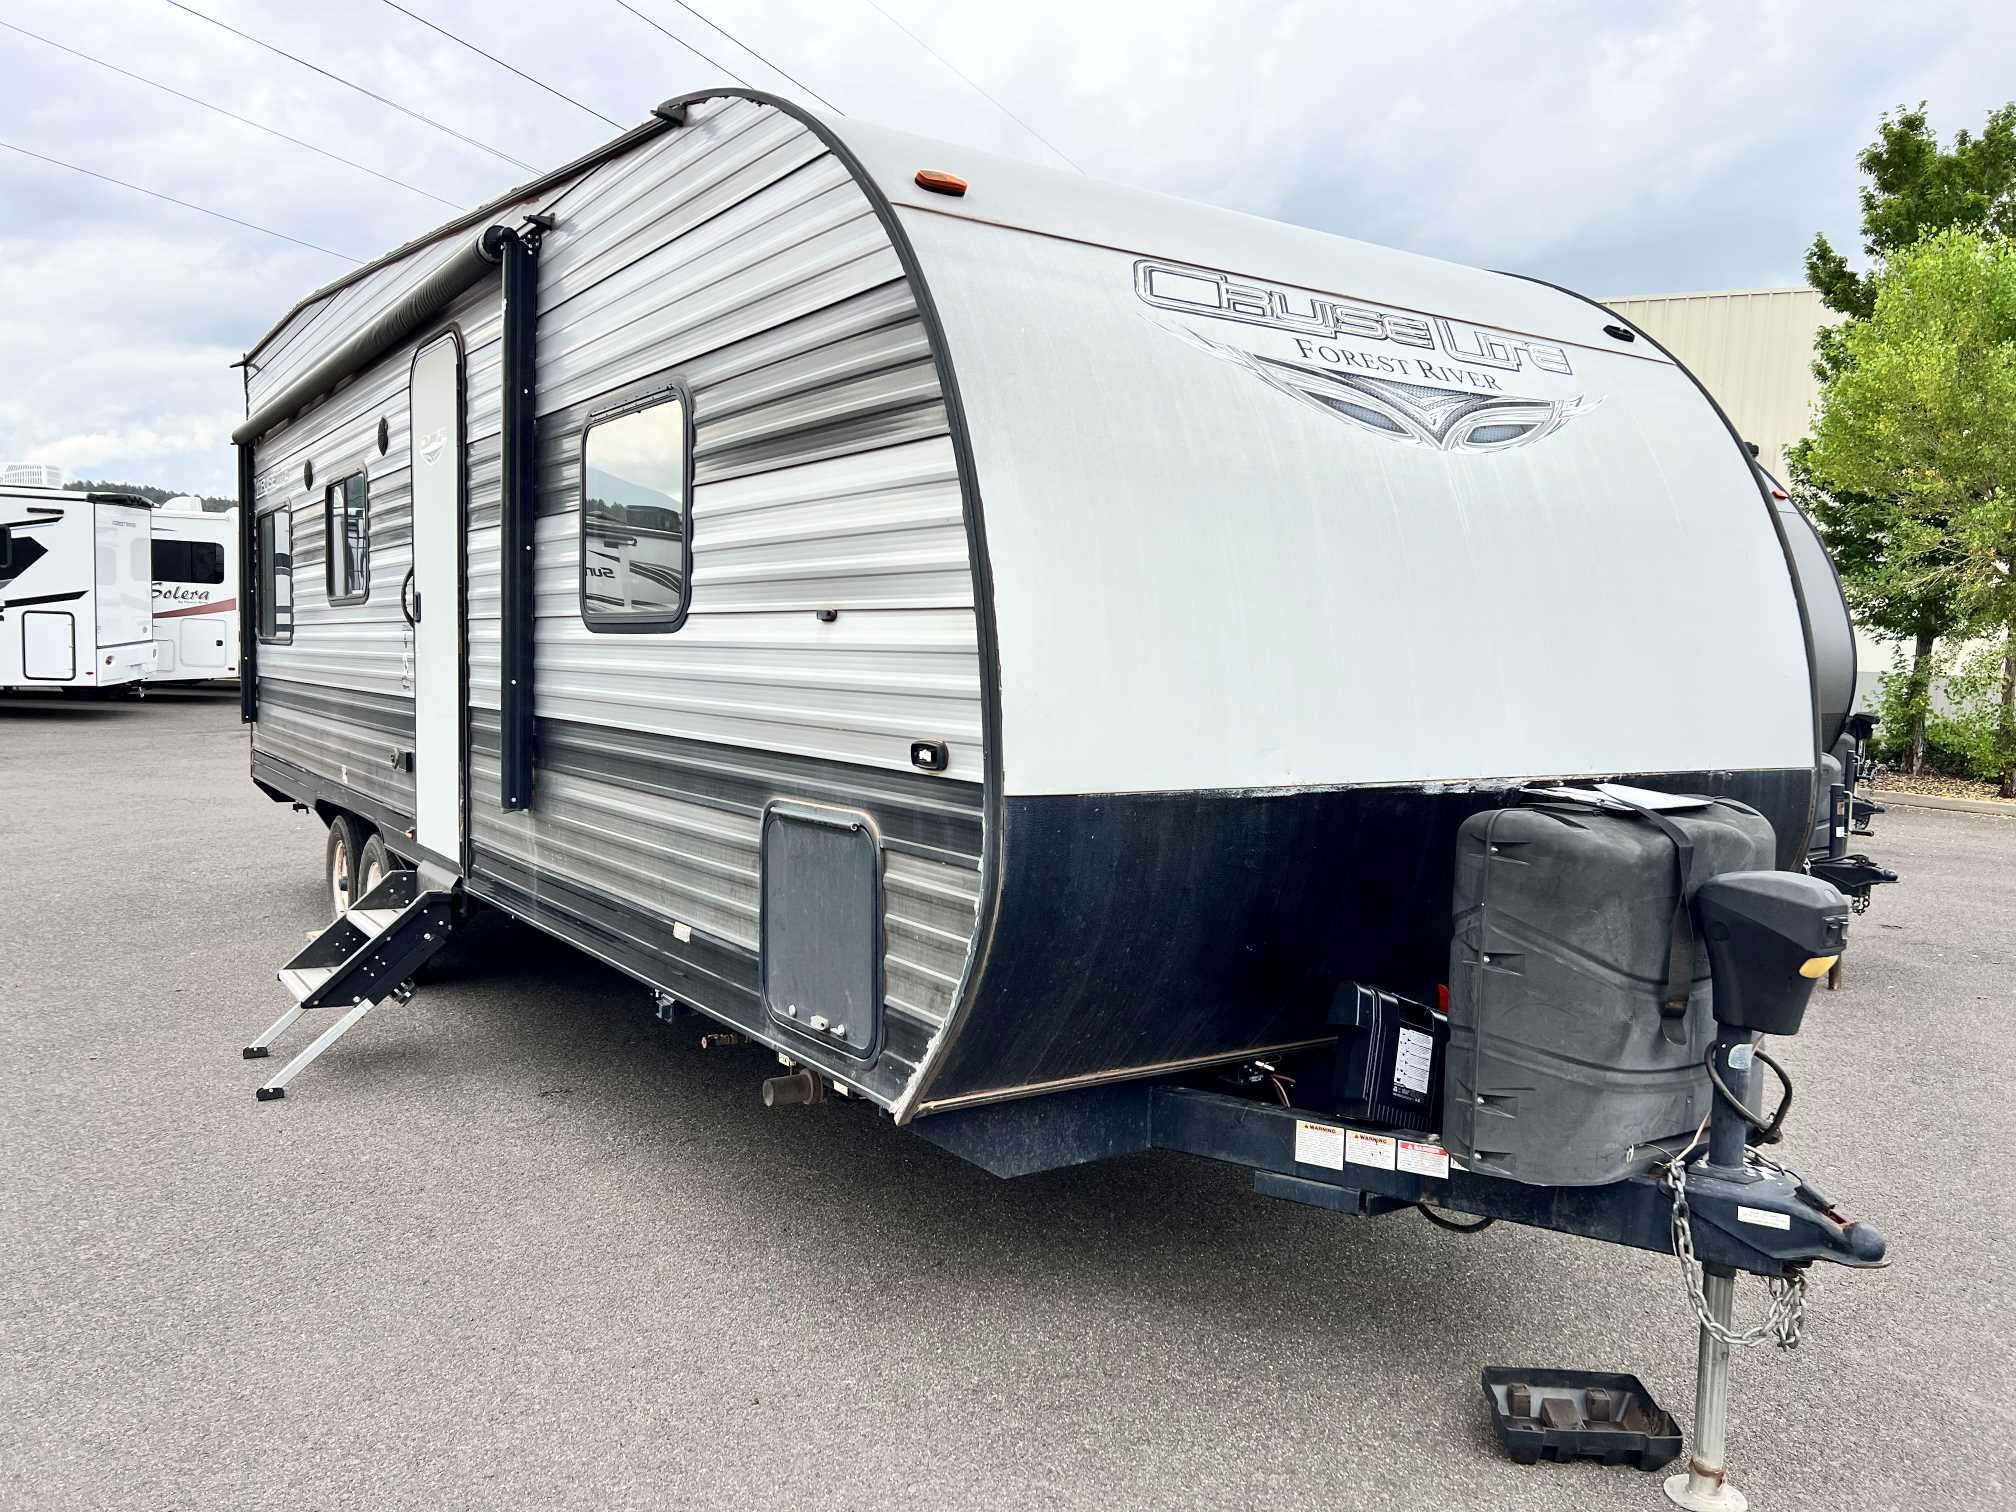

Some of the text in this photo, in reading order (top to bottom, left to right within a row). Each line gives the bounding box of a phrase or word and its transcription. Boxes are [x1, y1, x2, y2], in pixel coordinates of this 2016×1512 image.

[1296, 337, 1503, 391] FOREST RIVER
[152, 581, 210, 601] Solera
[1310, 1124, 1337, 1134] WARNING
[1360, 1134, 1388, 1145] WARNING
